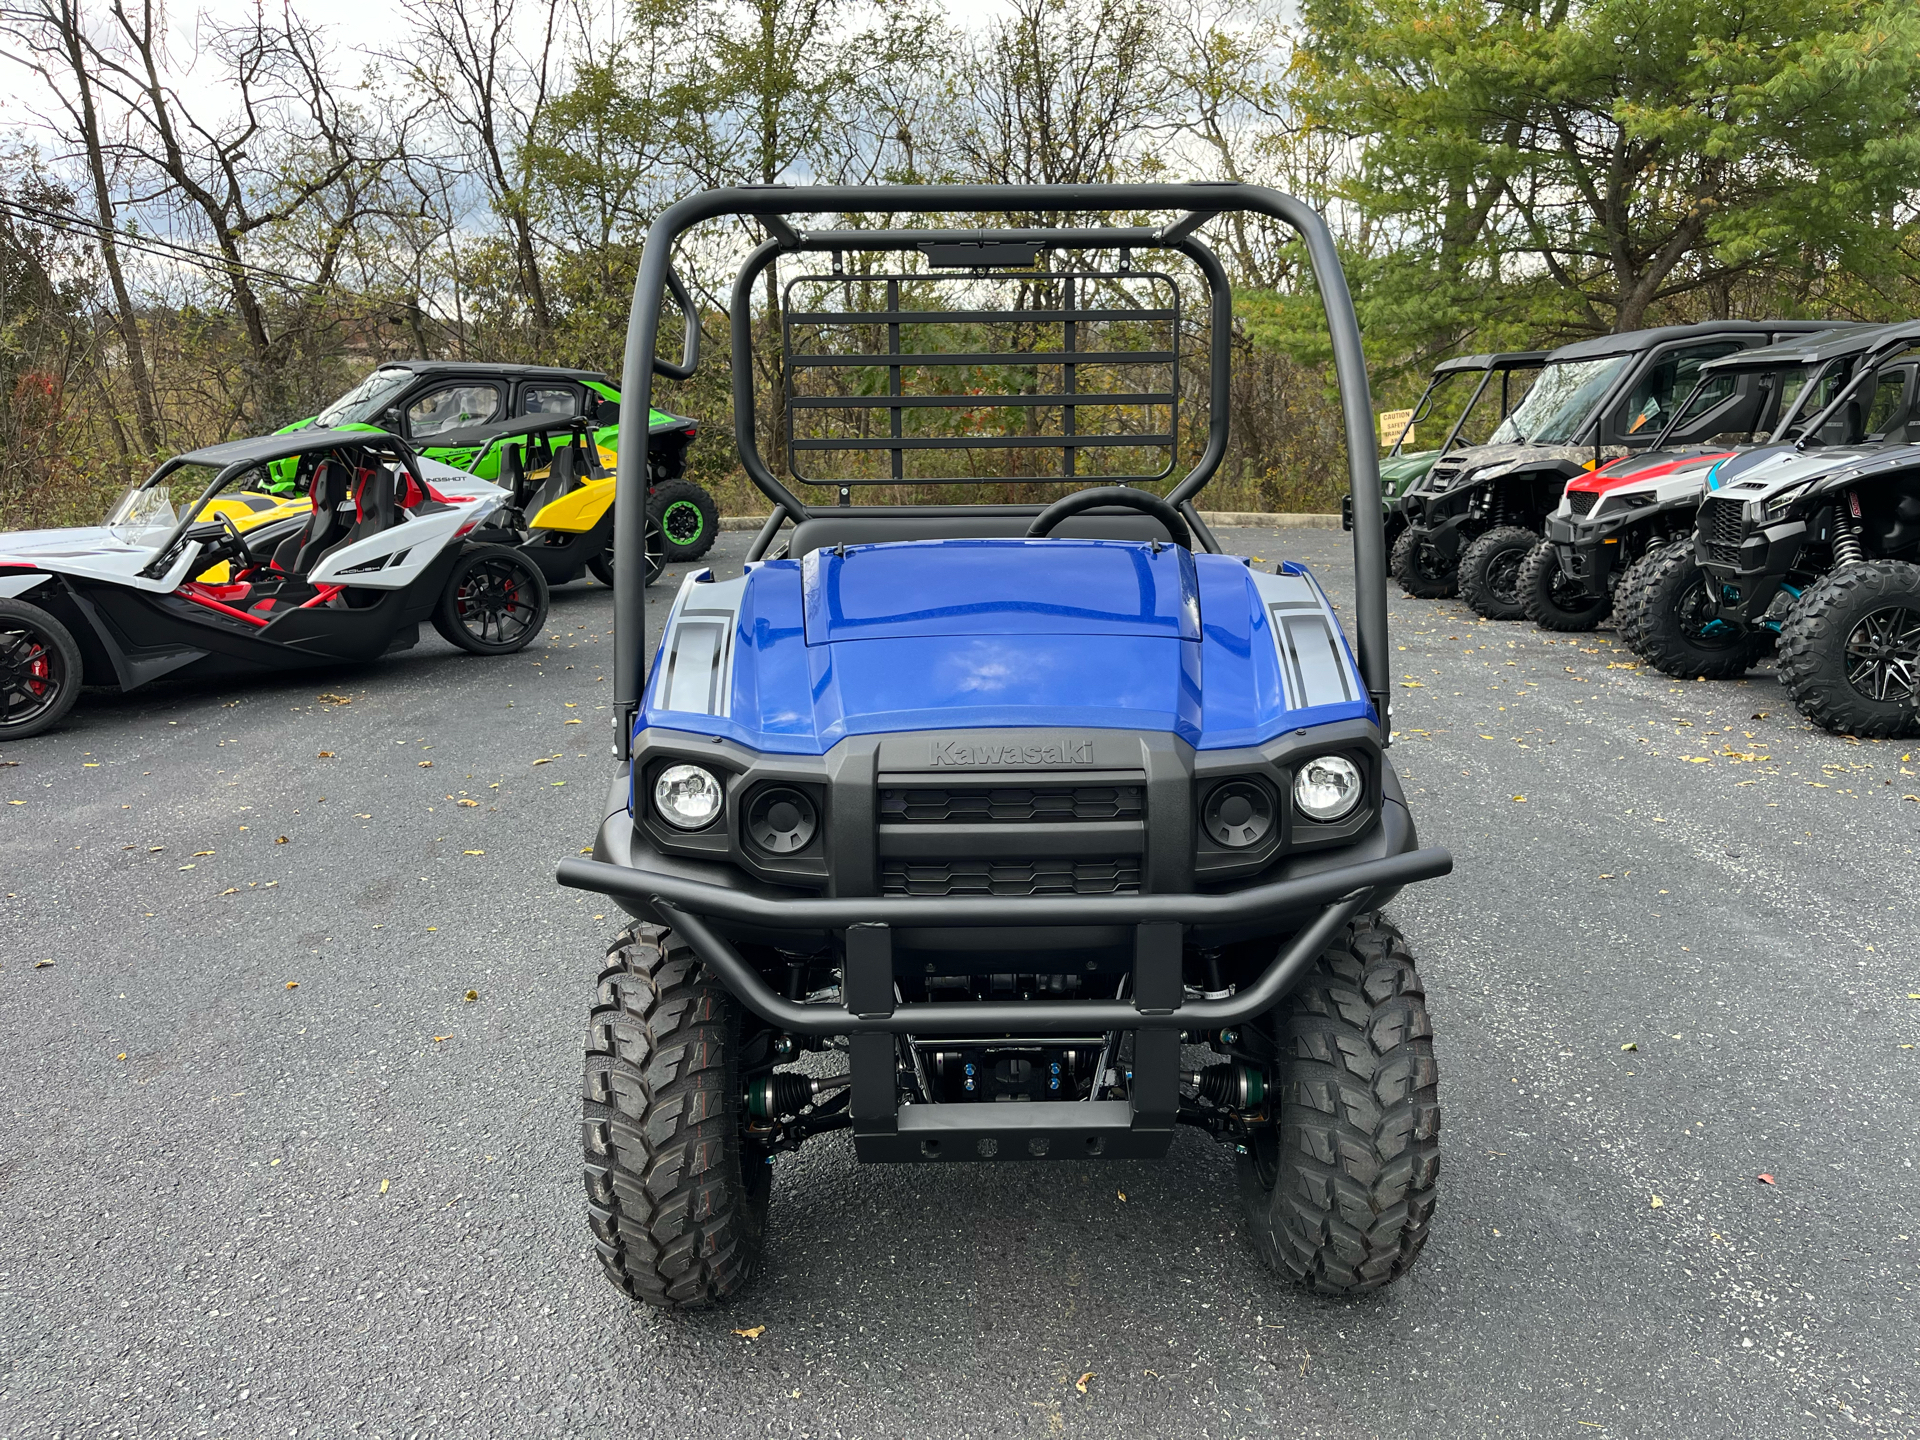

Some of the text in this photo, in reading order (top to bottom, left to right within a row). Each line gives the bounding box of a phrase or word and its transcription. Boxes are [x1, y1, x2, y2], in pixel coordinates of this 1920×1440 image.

[1383, 411, 1410, 420] CAUTION
[340, 566, 380, 575] ROUSH
[930, 740, 1094, 766] Kawasaki
